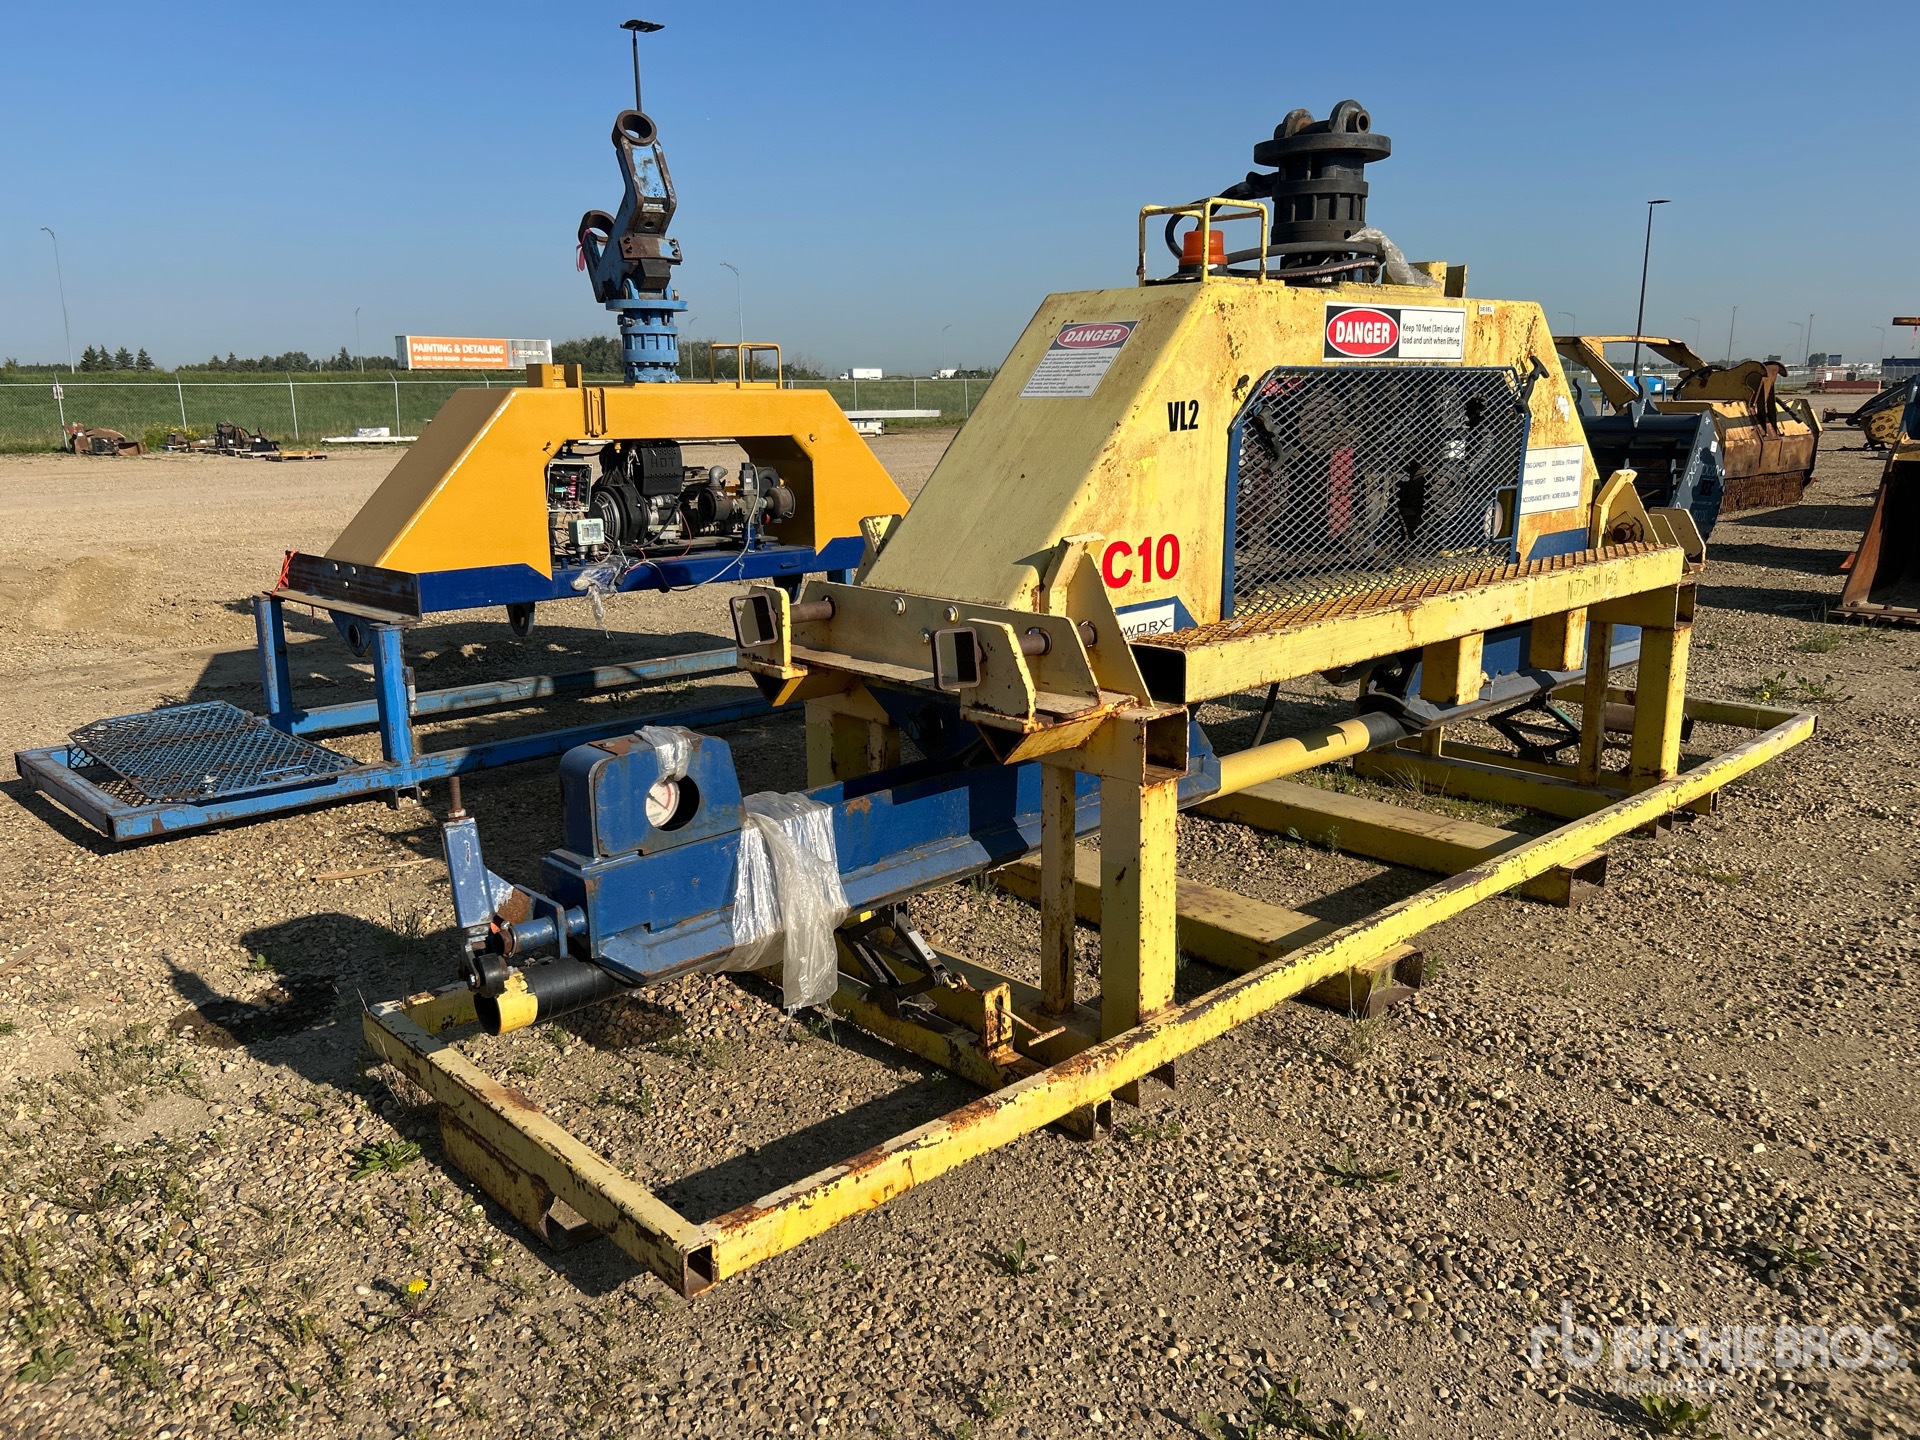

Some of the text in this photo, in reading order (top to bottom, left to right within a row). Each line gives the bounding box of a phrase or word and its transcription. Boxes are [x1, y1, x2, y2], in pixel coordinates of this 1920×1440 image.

[1335, 321, 1390, 344] DANGER
[1402, 323, 1460, 334] Keep 10 feet (3m) clear of
[1063, 328, 1122, 343] DANGER
[1402, 335, 1413, 344] load
[1413, 336, 1423, 345] and
[1423, 336, 1433, 345] unit
[1433, 337, 1446, 345] when
[412, 343, 504, 354] PAINTING & DETAILING
[1167, 399, 1199, 432] VL2
[651, 457, 676, 469] HOT
[1101, 533, 1180, 589] C10
